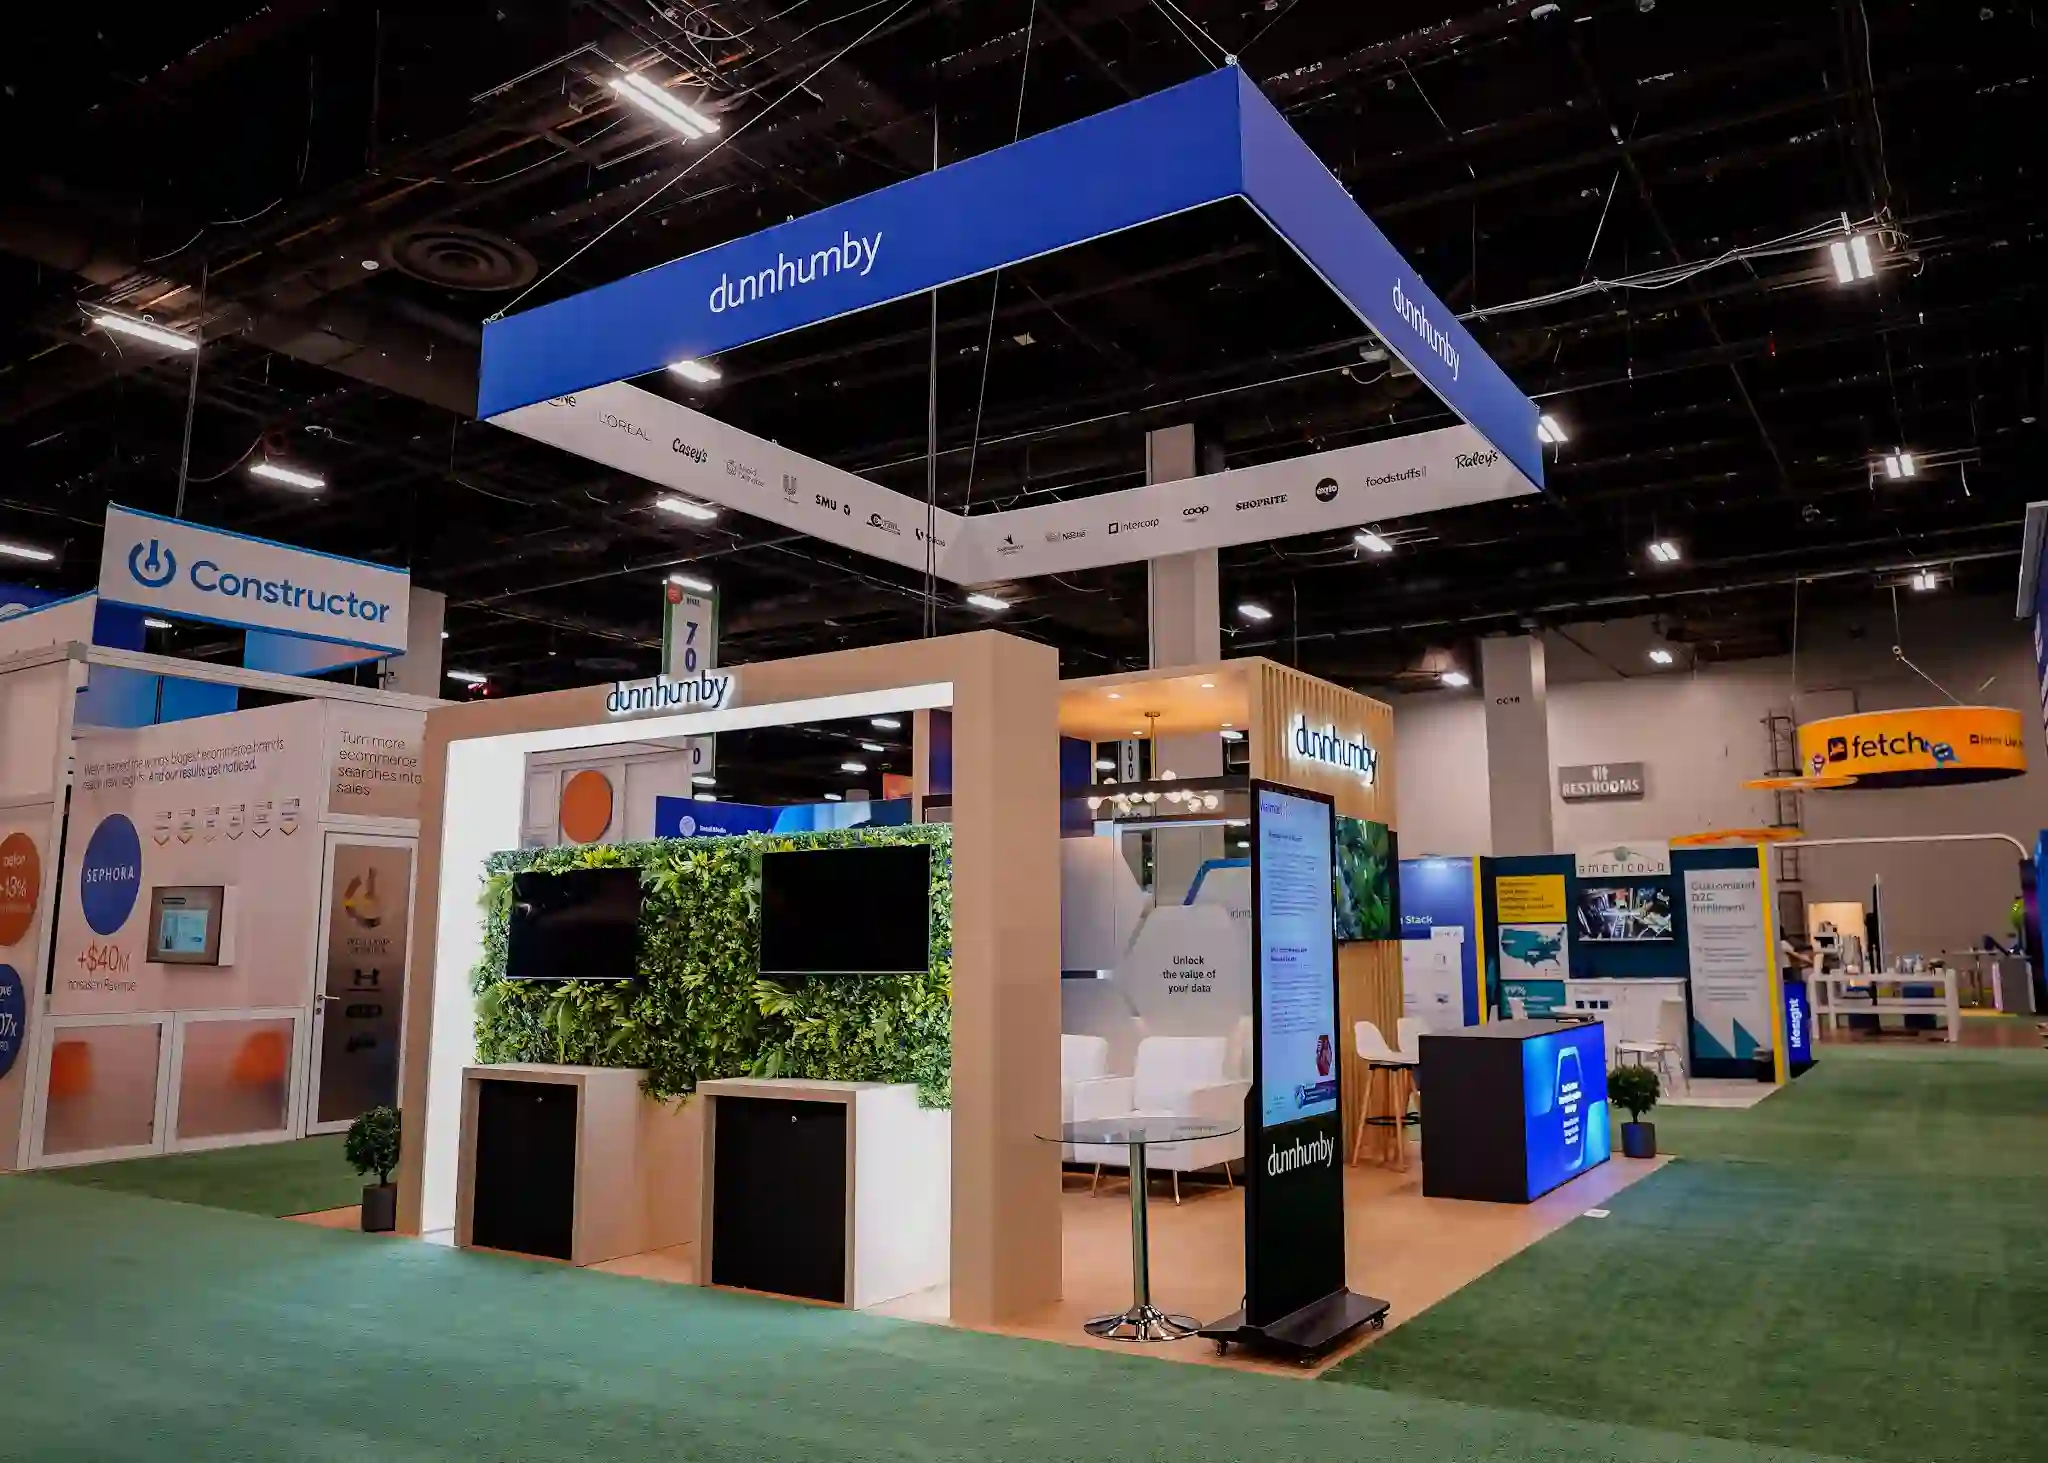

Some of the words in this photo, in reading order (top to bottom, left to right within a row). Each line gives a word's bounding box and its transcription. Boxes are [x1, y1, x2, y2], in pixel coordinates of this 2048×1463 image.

[708, 230, 883, 314] dunnhumby
[1392, 277, 1460, 382] dunnhumby
[672, 437, 708, 464] Casey's
[1455, 450, 1499, 469] Raley's
[1364, 467, 1421, 488] foodstuffs
[815, 493, 837, 511] SMU
[1182, 504, 1210, 516] coop
[1235, 493, 1288, 512] SHOPRITE
[190, 560, 390, 623] Constructor
[606, 669, 729, 712] dunnhumby
[340, 730, 370, 745] Turn
[372, 737, 405, 750] more
[1296, 715, 1378, 785] dunnhumby
[1852, 731, 1928, 759] fetch
[339, 749, 417, 768] ecommerce
[149, 771, 164, 783] And
[164, 769, 180, 781] our
[179, 763, 206, 779] results
[207, 763, 222, 779] get
[222, 756, 258, 774] noticed.
[338, 766, 397, 781] searches
[399, 771, 423, 785] into
[336, 782, 371, 796] sales
[1562, 779, 1640, 797] RESTROOMS
[86, 864, 135, 884] SEPHORA
[1405, 915, 1433, 925] Stack
[77, 938, 132, 974] +$40M
[1172, 955, 1205, 965] Unlock
[1162, 969, 1177, 979] the
[1179, 969, 1204, 980] value
[1206, 969, 1217, 979] of
[1168, 984, 1189, 995] your
[1191, 983, 1212, 993] data
[1791, 998, 1800, 1049] lifesight
[1267, 1130, 1335, 1177] dunnhumby
